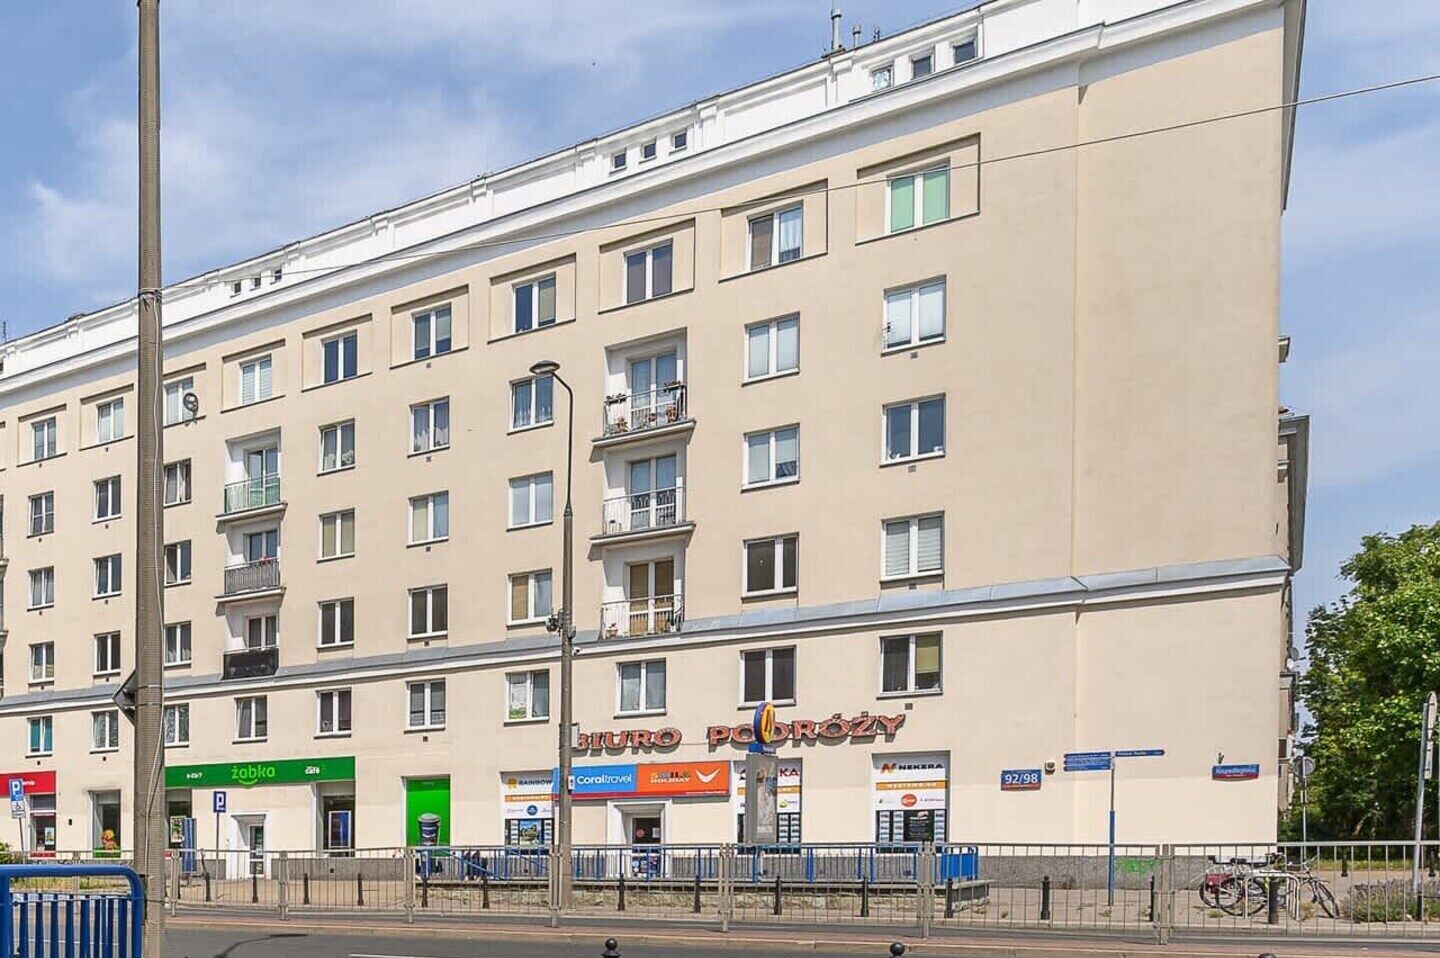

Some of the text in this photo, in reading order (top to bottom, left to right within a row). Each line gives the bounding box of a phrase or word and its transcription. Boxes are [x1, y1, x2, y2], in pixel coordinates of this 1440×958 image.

[707, 711, 906, 745] PODRÓŻY
[231, 765, 276, 780] żabka
[1005, 774, 1039, 785] 92/98
[12, 781, 21, 795] P
[216, 793, 225, 811] P
